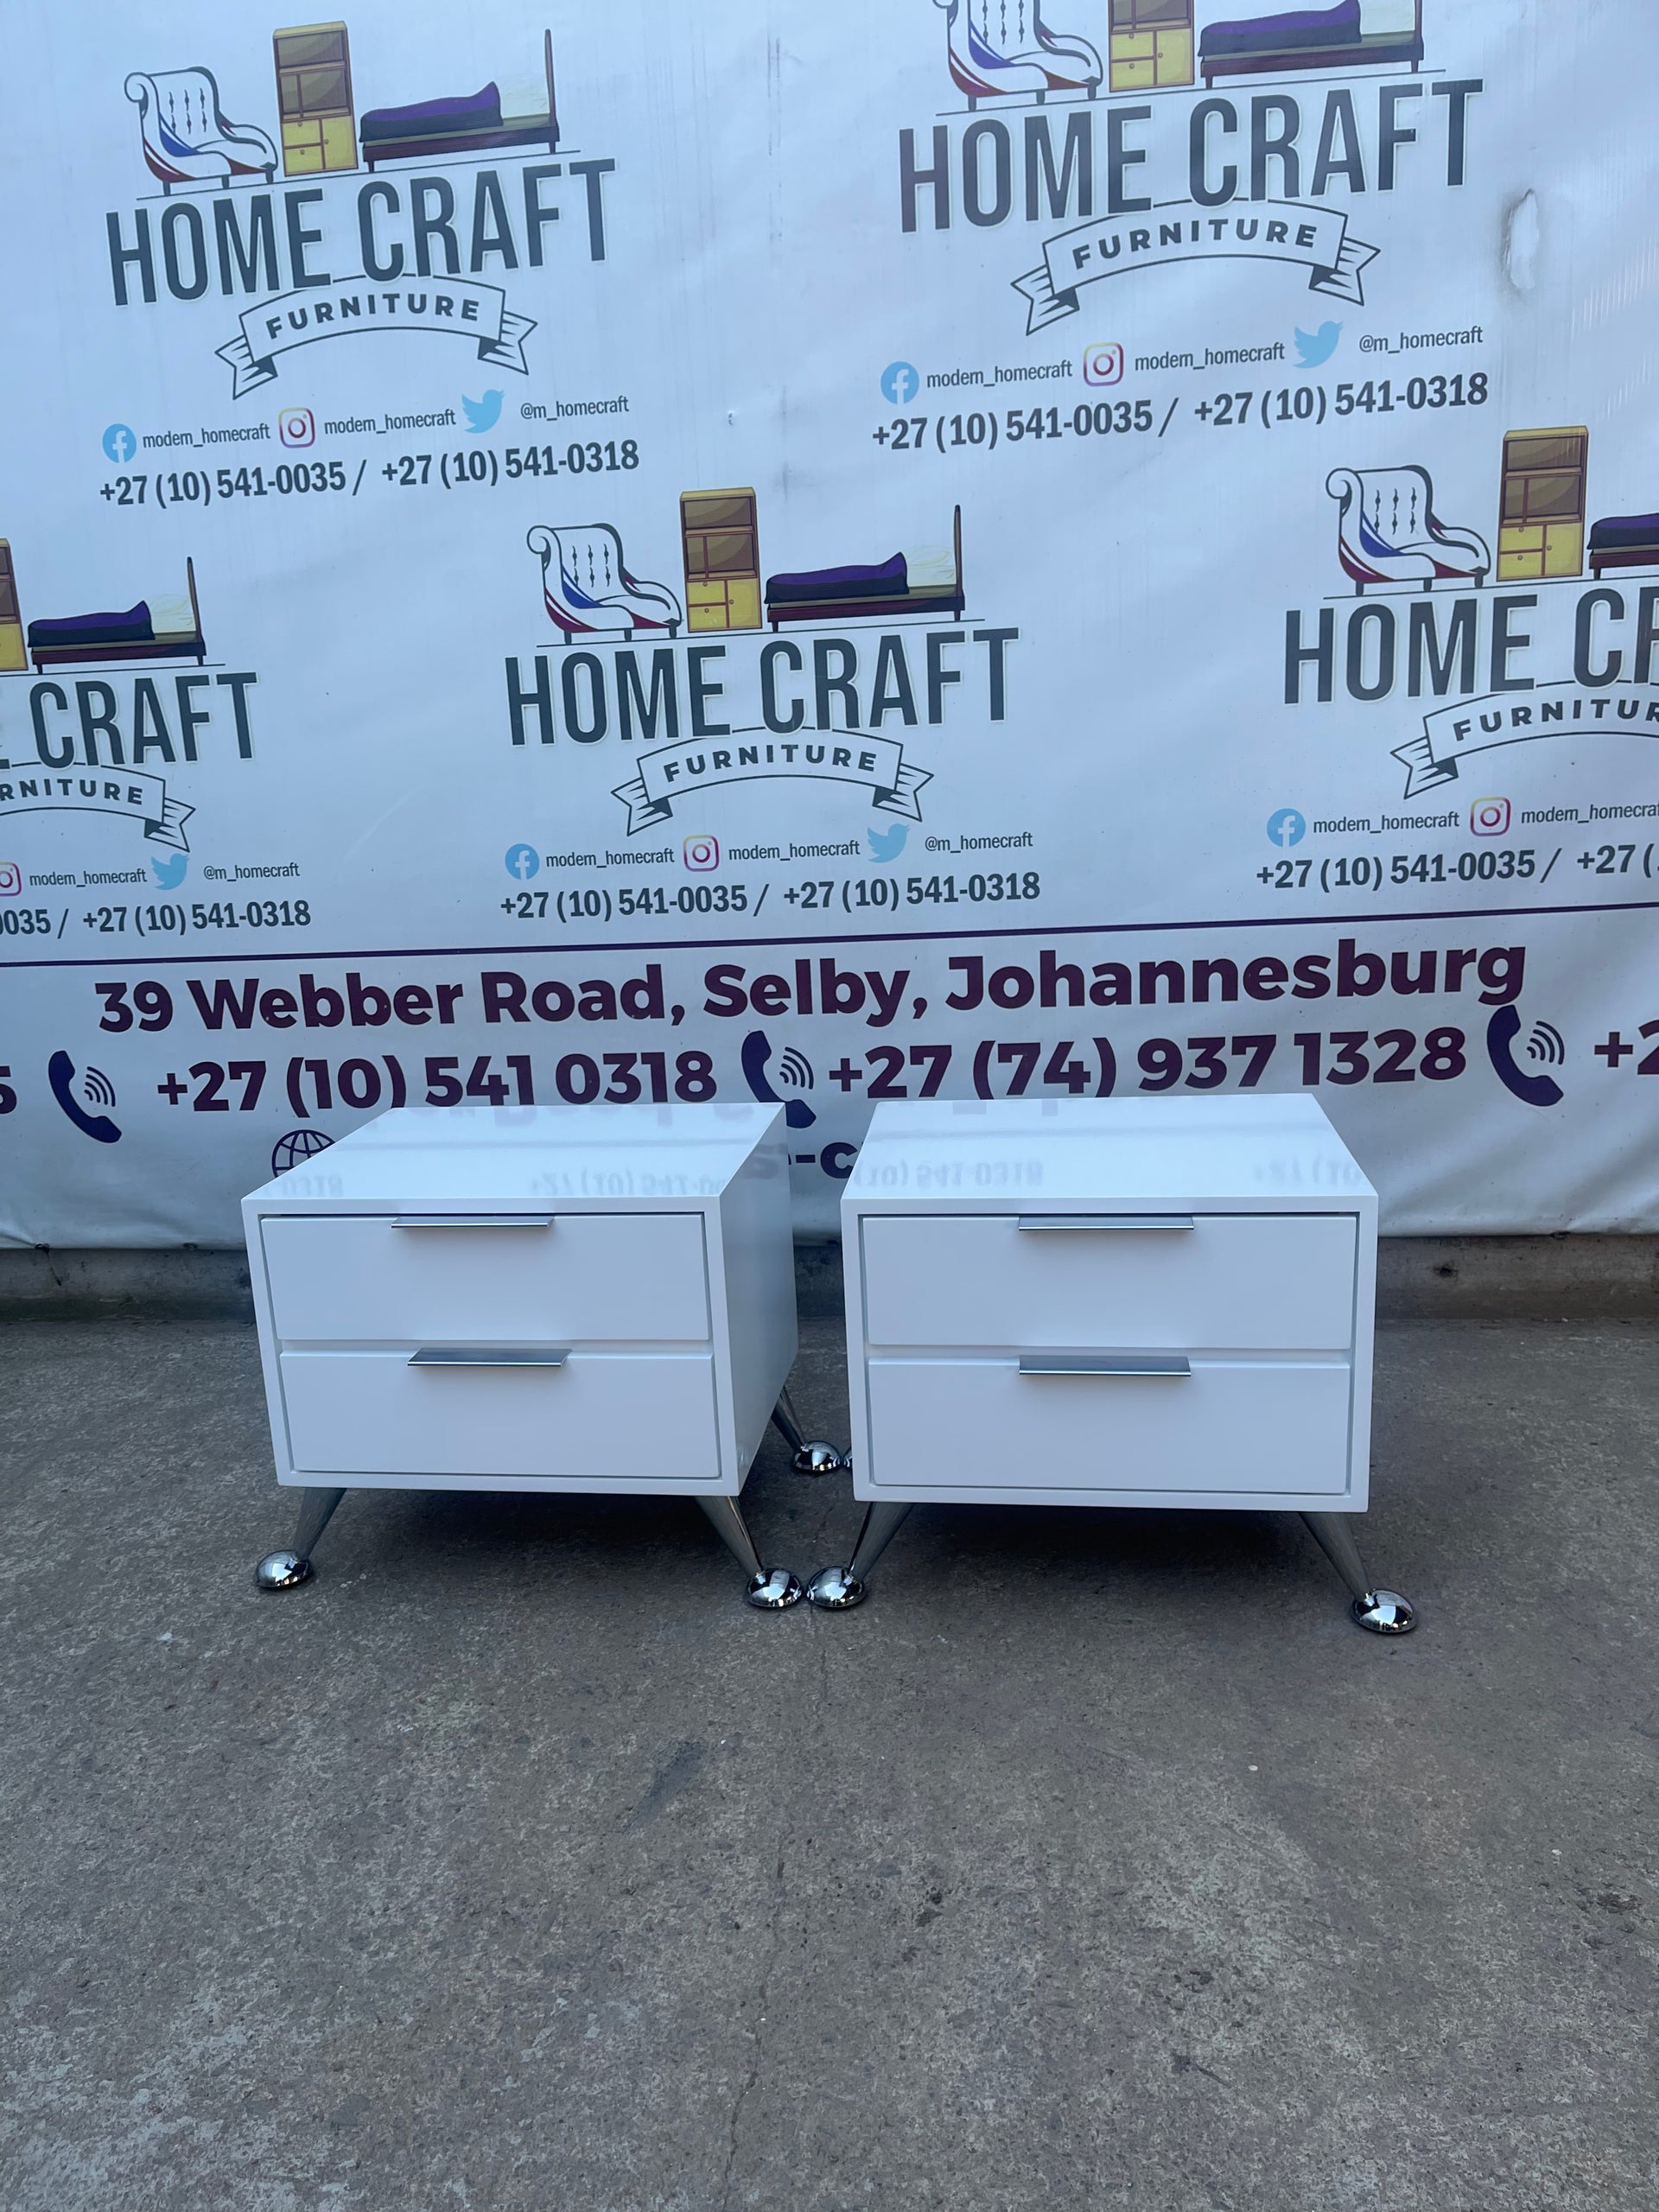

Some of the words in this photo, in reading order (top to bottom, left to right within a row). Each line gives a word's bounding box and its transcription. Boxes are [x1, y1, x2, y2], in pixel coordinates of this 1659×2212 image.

[899, 105, 1151, 232] HOME
[1190, 79, 1483, 207] CRAFT
[106, 188, 331, 306] HOME
[358, 159, 615, 282] CRAFT
[1072, 219, 1317, 270] FURNITURE
[266, 294, 479, 340] FURNITURE
[1360, 326, 1483, 353] @m_homecraft
[521, 396, 629, 421] @m_homecraft
[873, 417, 927, 449] +27
[937, 412, 997, 453] (10)
[1007, 400, 1152, 441] 541-0035
[1195, 392, 1253, 425] +27
[1262, 386, 1325, 429] (10)
[1335, 372, 1487, 415] 541-0318
[100, 475, 147, 505] +27
[156, 471, 210, 509] (10)
[217, 461, 346, 498] 541-0035
[382, 454, 431, 485] +27
[441, 450, 498, 489] (10)
[505, 440, 639, 478] 541-0318
[1285, 594, 1537, 704] HOME
[505, 645, 730, 745] HOME
[760, 627, 1019, 734] CRAFT
[29, 672, 257, 768] CRAFT
[664, 745, 876, 782] FURNITURE
[204, 862, 300, 881] @m_homecraft
[925, 832, 1033, 853] @m_homecraft
[1257, 860, 1313, 888] +27
[1320, 857, 1382, 893] (10)
[1390, 849, 1535, 884] 541-0035
[1577, 844, 1636, 874] +27
[83, 906, 127, 931] +27
[135, 905, 186, 937] (10)
[192, 900, 310, 929] 541-0318
[501, 892, 549, 918] +27
[557, 890, 612, 923] (10)
[619, 885, 747, 915] 541-0035
[784, 881, 834, 908] +27
[842, 879, 899, 912] (10)
[906, 872, 1039, 904] 541-0318
[95, 981, 173, 1033] 39
[186, 972, 463, 1030] Webber
[480, 963, 685, 1026] Road,
[703, 958, 927, 1027] Selby,
[945, 938, 1526, 1010] Johannesburg
[157, 1061, 266, 1111] +27
[287, 1055, 406, 1118] (10)
[425, 1055, 535, 1107] 541
[556, 1051, 717, 1105] 0318
[830, 1045, 952, 1101] +27
[973, 1038, 1116, 1100] (74)
[1137, 1034, 1276, 1091] 937
[1294, 1027, 1466, 1085] 1328
